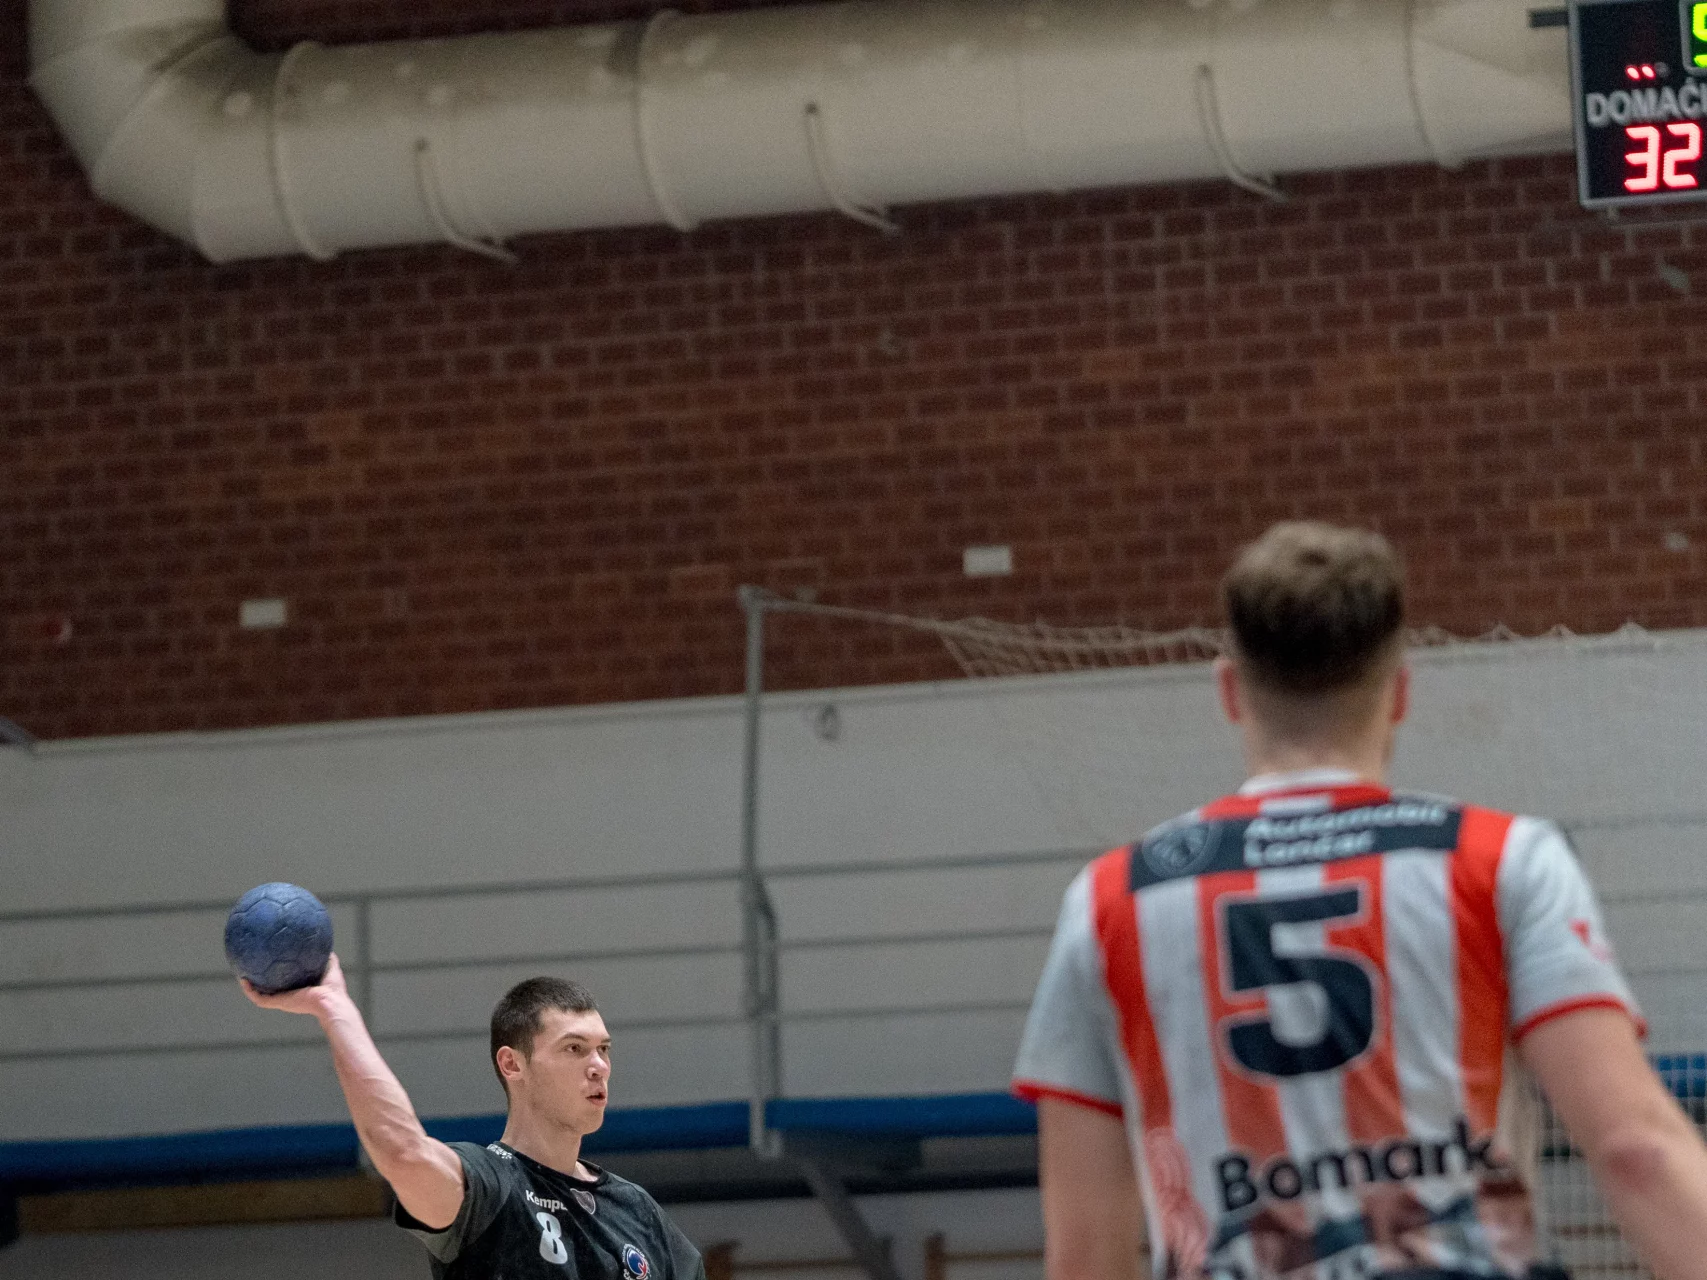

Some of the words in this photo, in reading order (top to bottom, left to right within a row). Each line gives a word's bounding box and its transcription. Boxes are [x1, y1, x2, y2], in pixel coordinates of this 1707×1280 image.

[1624, 122, 1702, 191] 32
[1222, 884, 1380, 1081] 5
[1216, 1115, 1505, 1213] Bomark
[536, 1211, 568, 1265] 8
